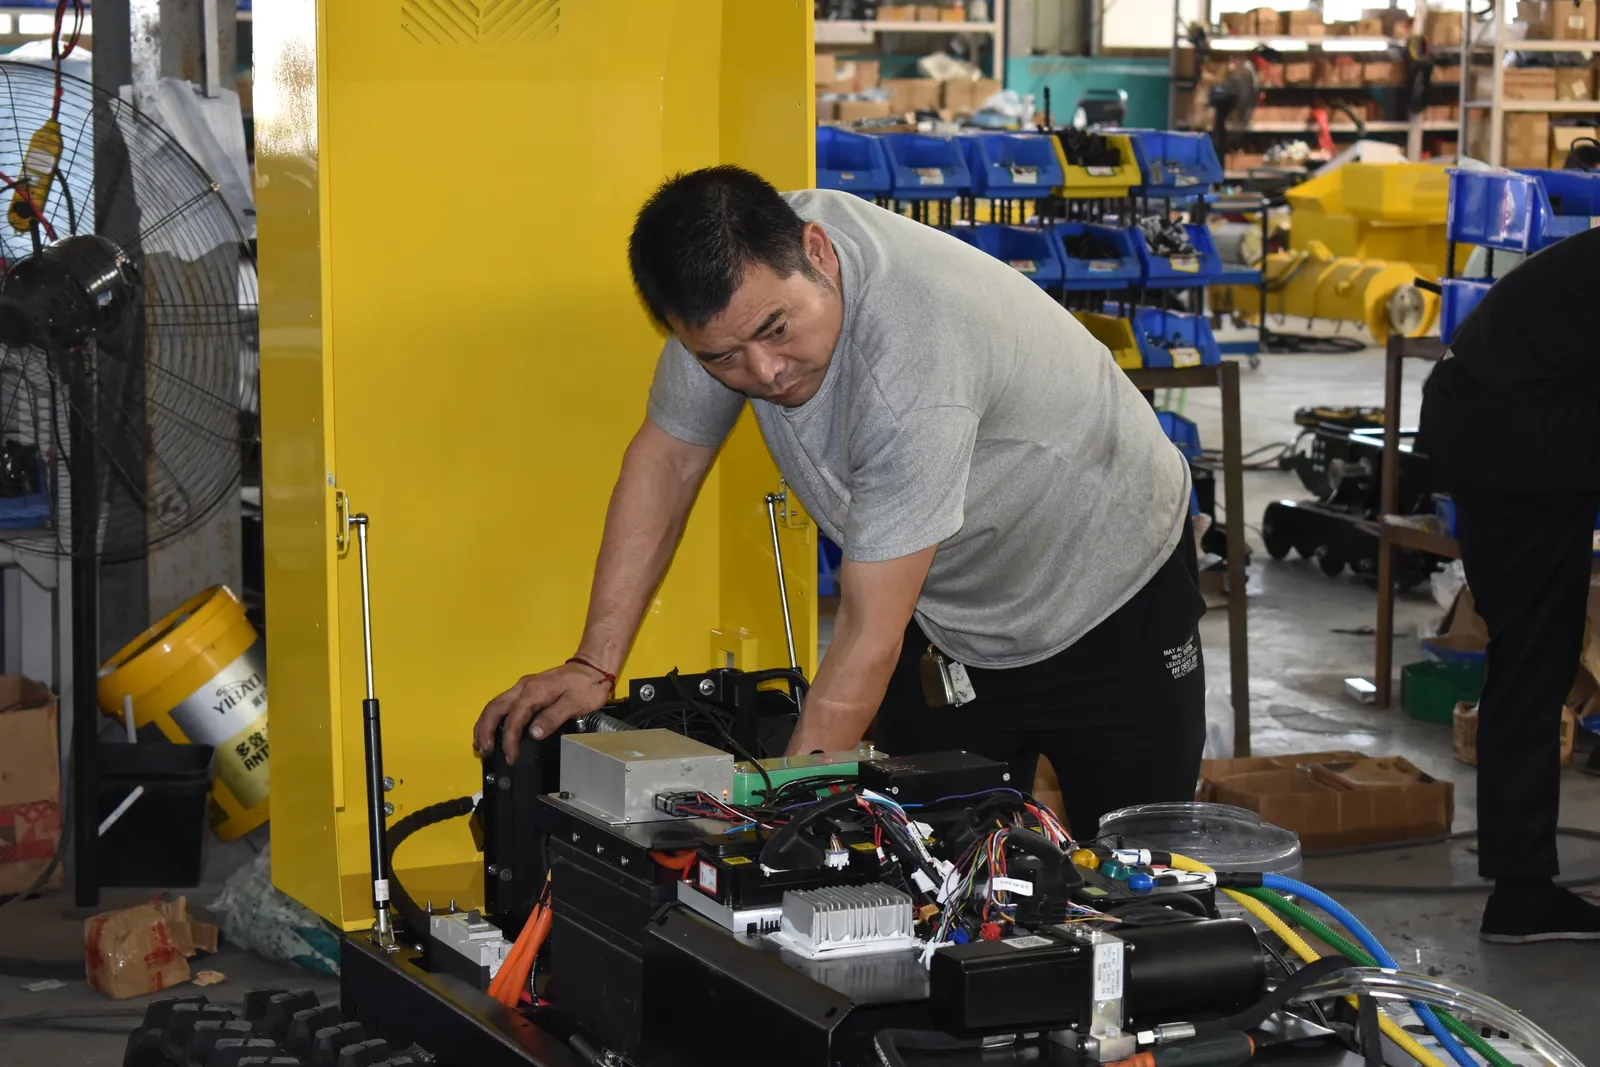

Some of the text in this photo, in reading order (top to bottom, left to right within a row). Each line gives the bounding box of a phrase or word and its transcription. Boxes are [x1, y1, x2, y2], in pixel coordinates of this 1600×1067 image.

[1163, 648, 1176, 656] MAY
[1171, 652, 1183, 660] WHO
[1165, 658, 1181, 669] LEAVE
[235, 724, 268, 760] 多效
